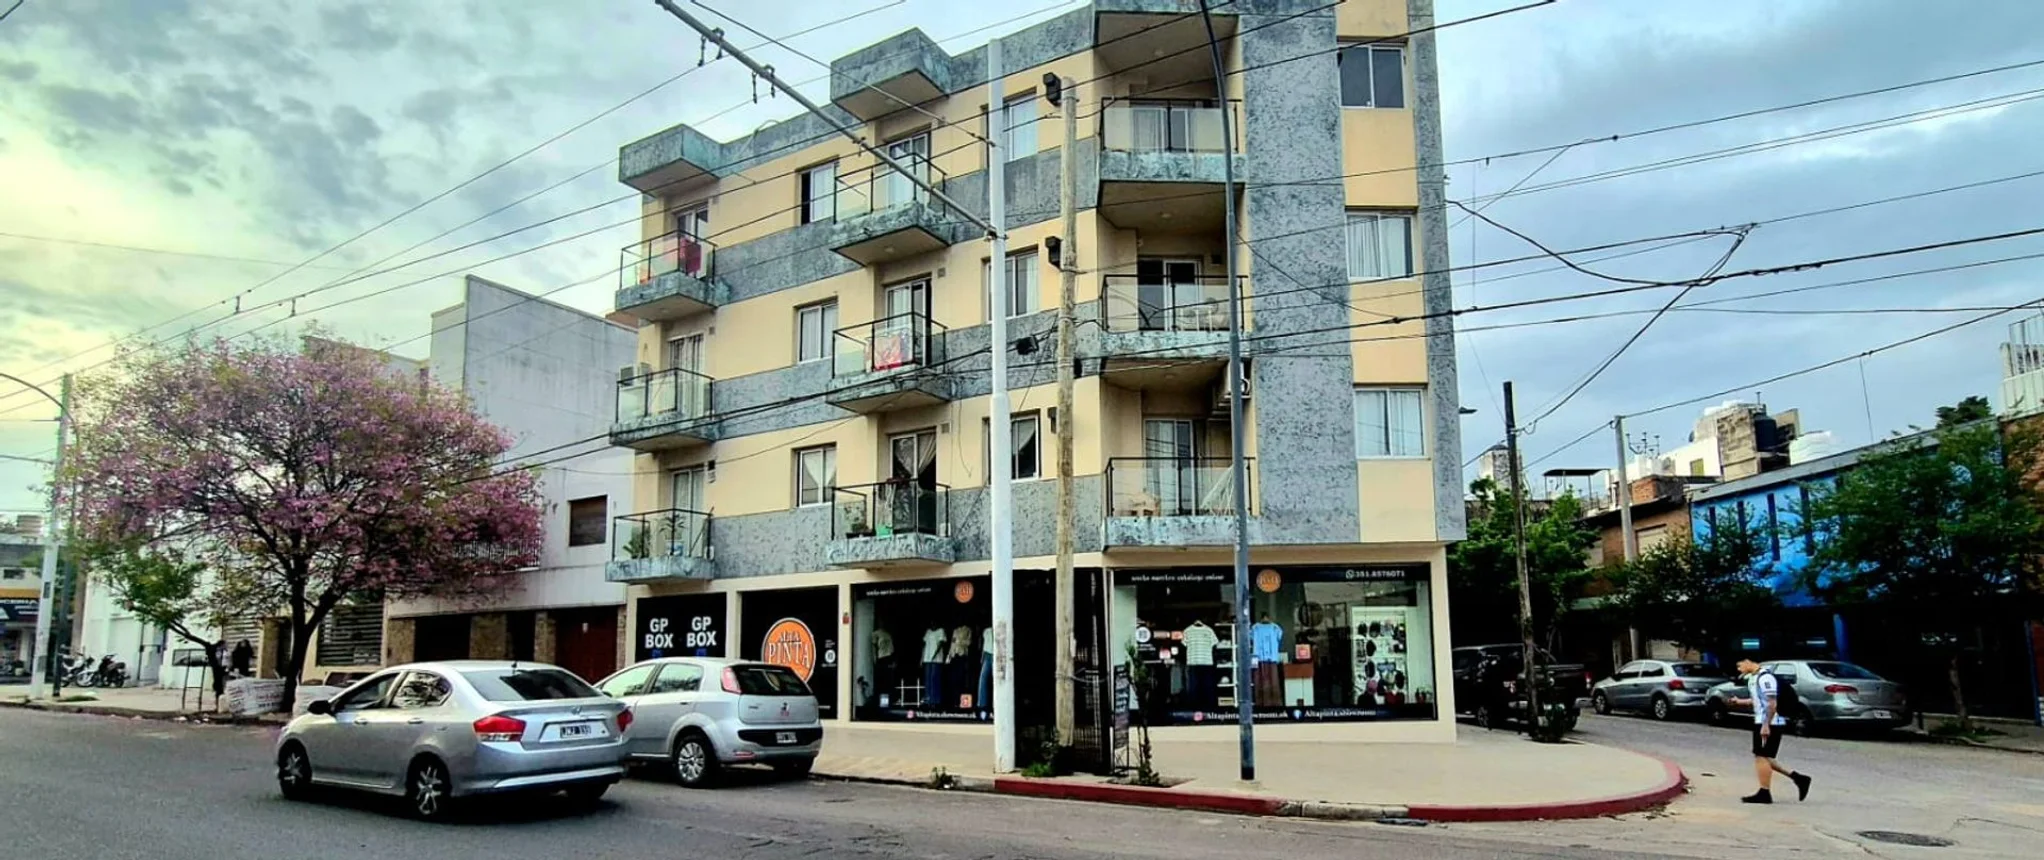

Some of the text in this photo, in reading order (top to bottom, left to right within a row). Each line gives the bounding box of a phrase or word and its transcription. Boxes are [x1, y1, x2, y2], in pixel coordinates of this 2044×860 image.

[649, 618, 669, 633] GP
[691, 616, 712, 631] GP
[645, 633, 674, 649] BOX
[686, 631, 717, 648] BOX
[767, 642, 811, 669] PINTA
